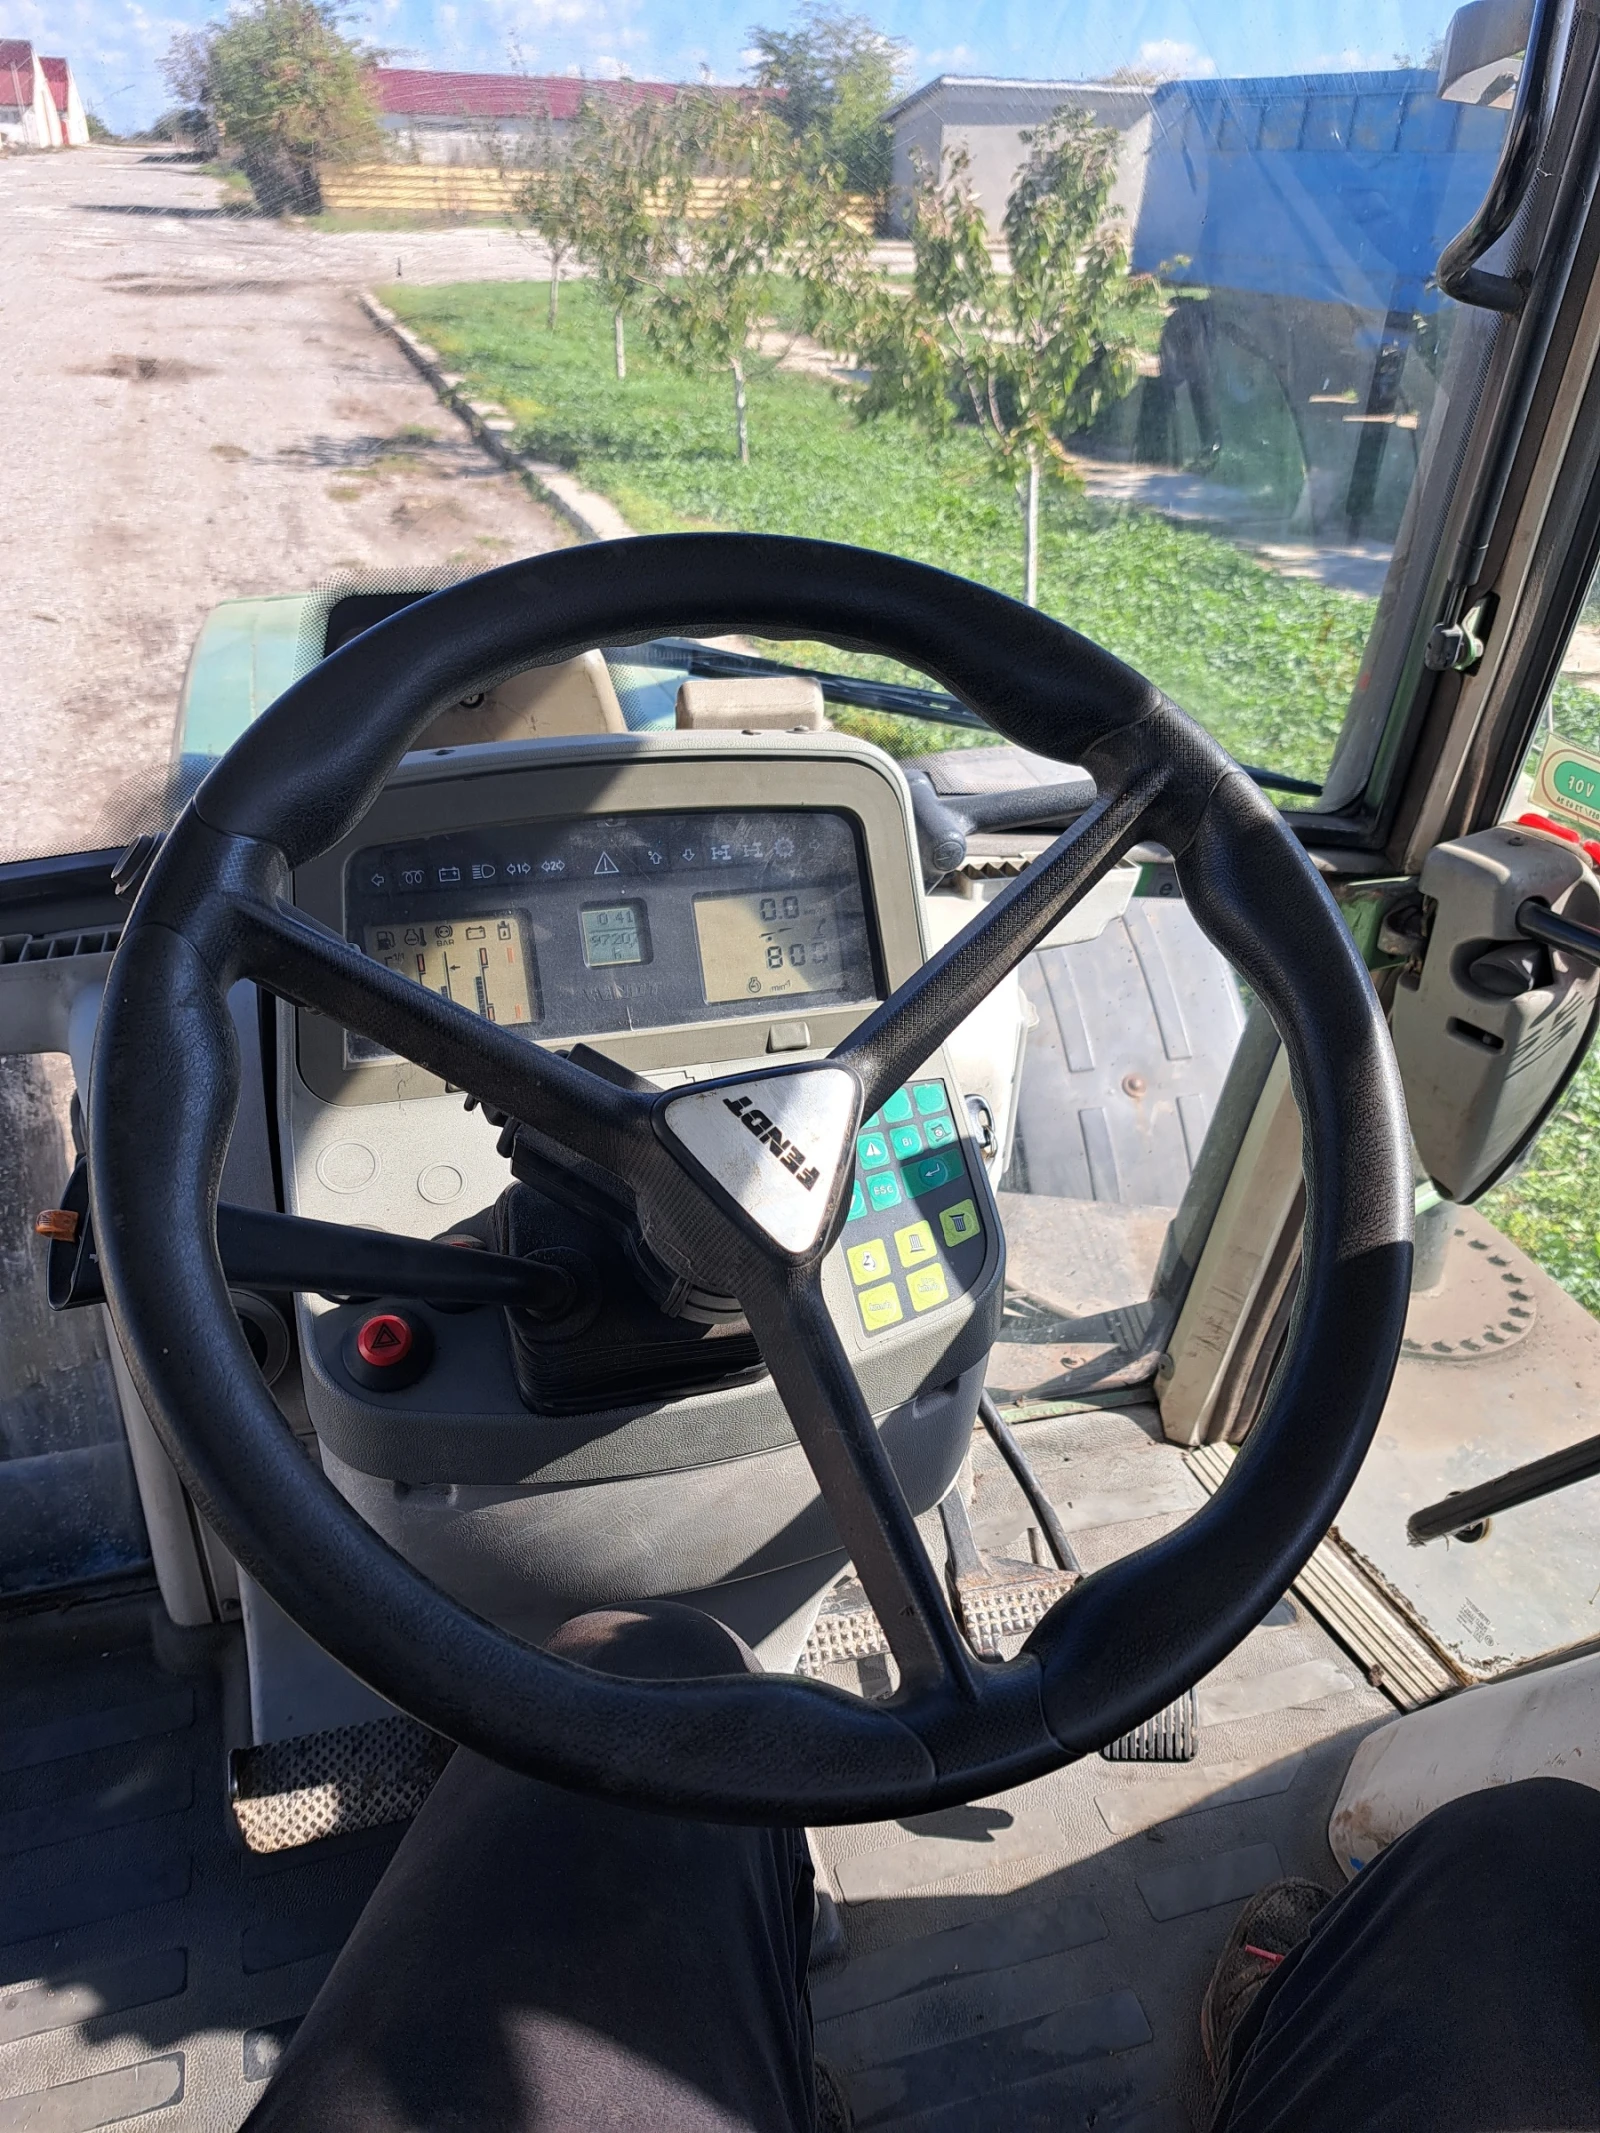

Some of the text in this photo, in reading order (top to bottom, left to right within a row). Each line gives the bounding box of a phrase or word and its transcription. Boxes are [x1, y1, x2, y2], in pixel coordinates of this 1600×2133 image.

[436, 939, 455, 947] BAR
[722, 1095, 821, 1192] FENDT
[873, 1185, 894, 1196] ESC
